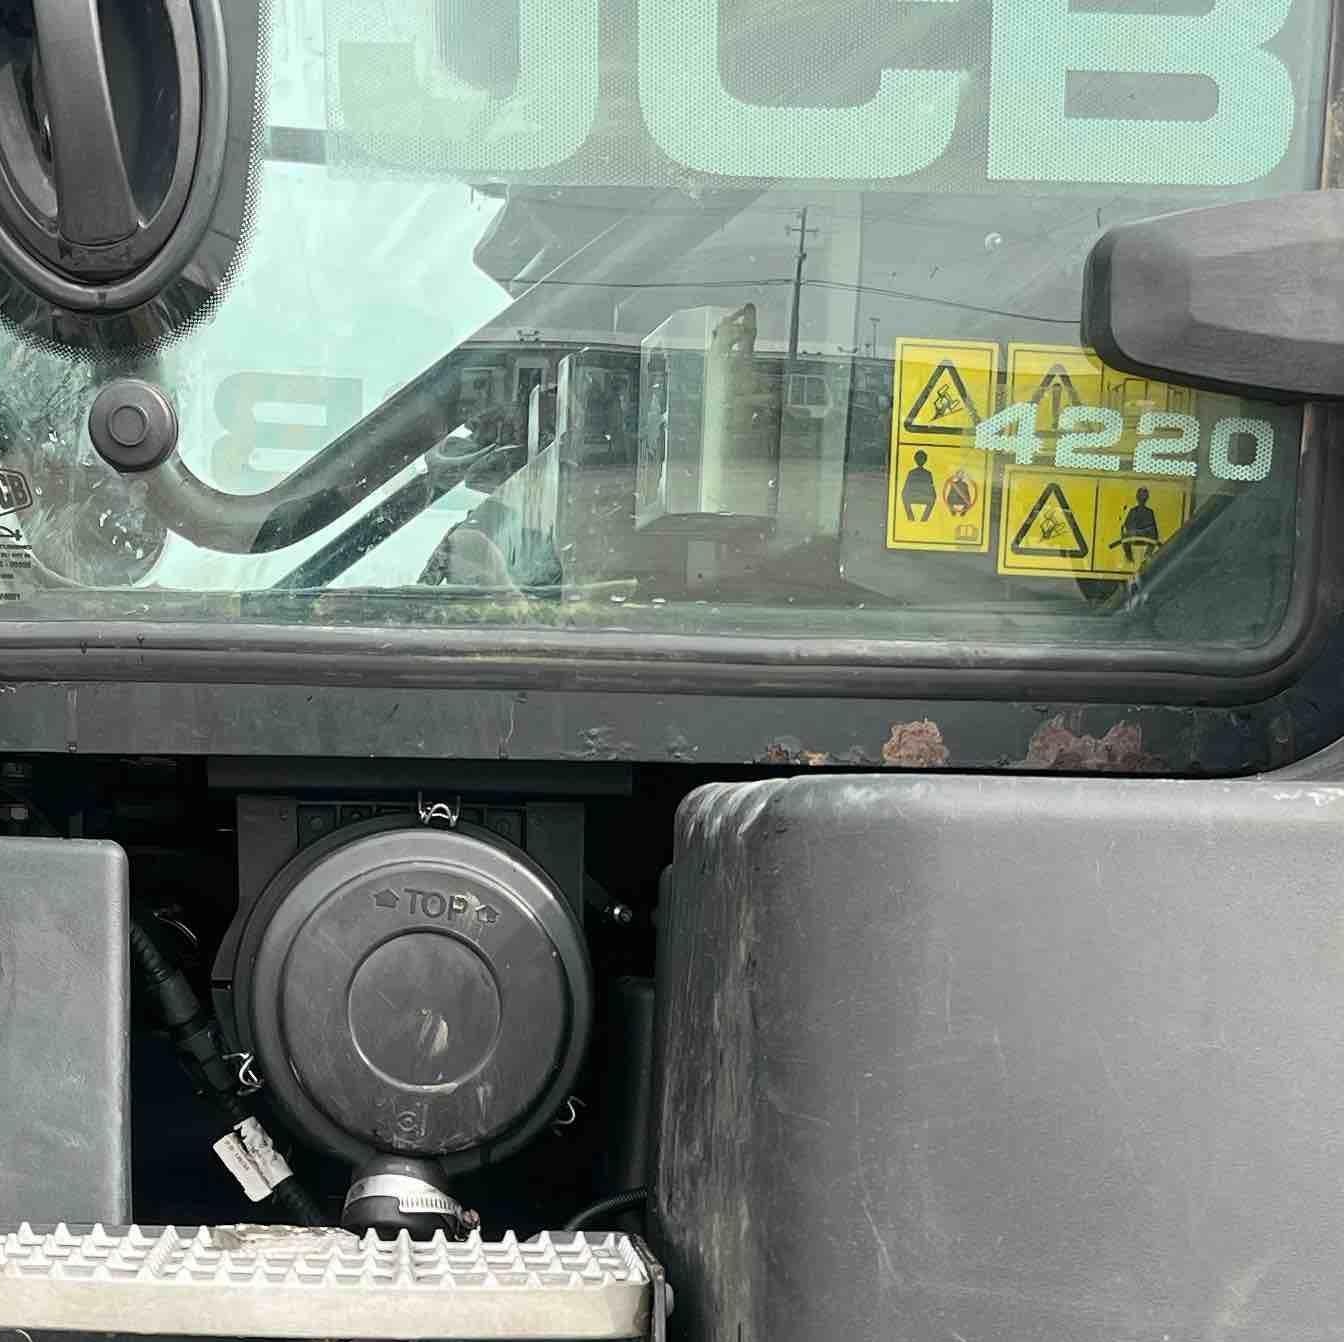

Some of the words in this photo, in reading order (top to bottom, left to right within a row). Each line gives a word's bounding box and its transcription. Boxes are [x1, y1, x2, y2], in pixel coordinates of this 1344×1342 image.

[337, 0, 1296, 185] JCB
[975, 401, 1275, 481] 4220
[403, 887, 468, 921] TOP
